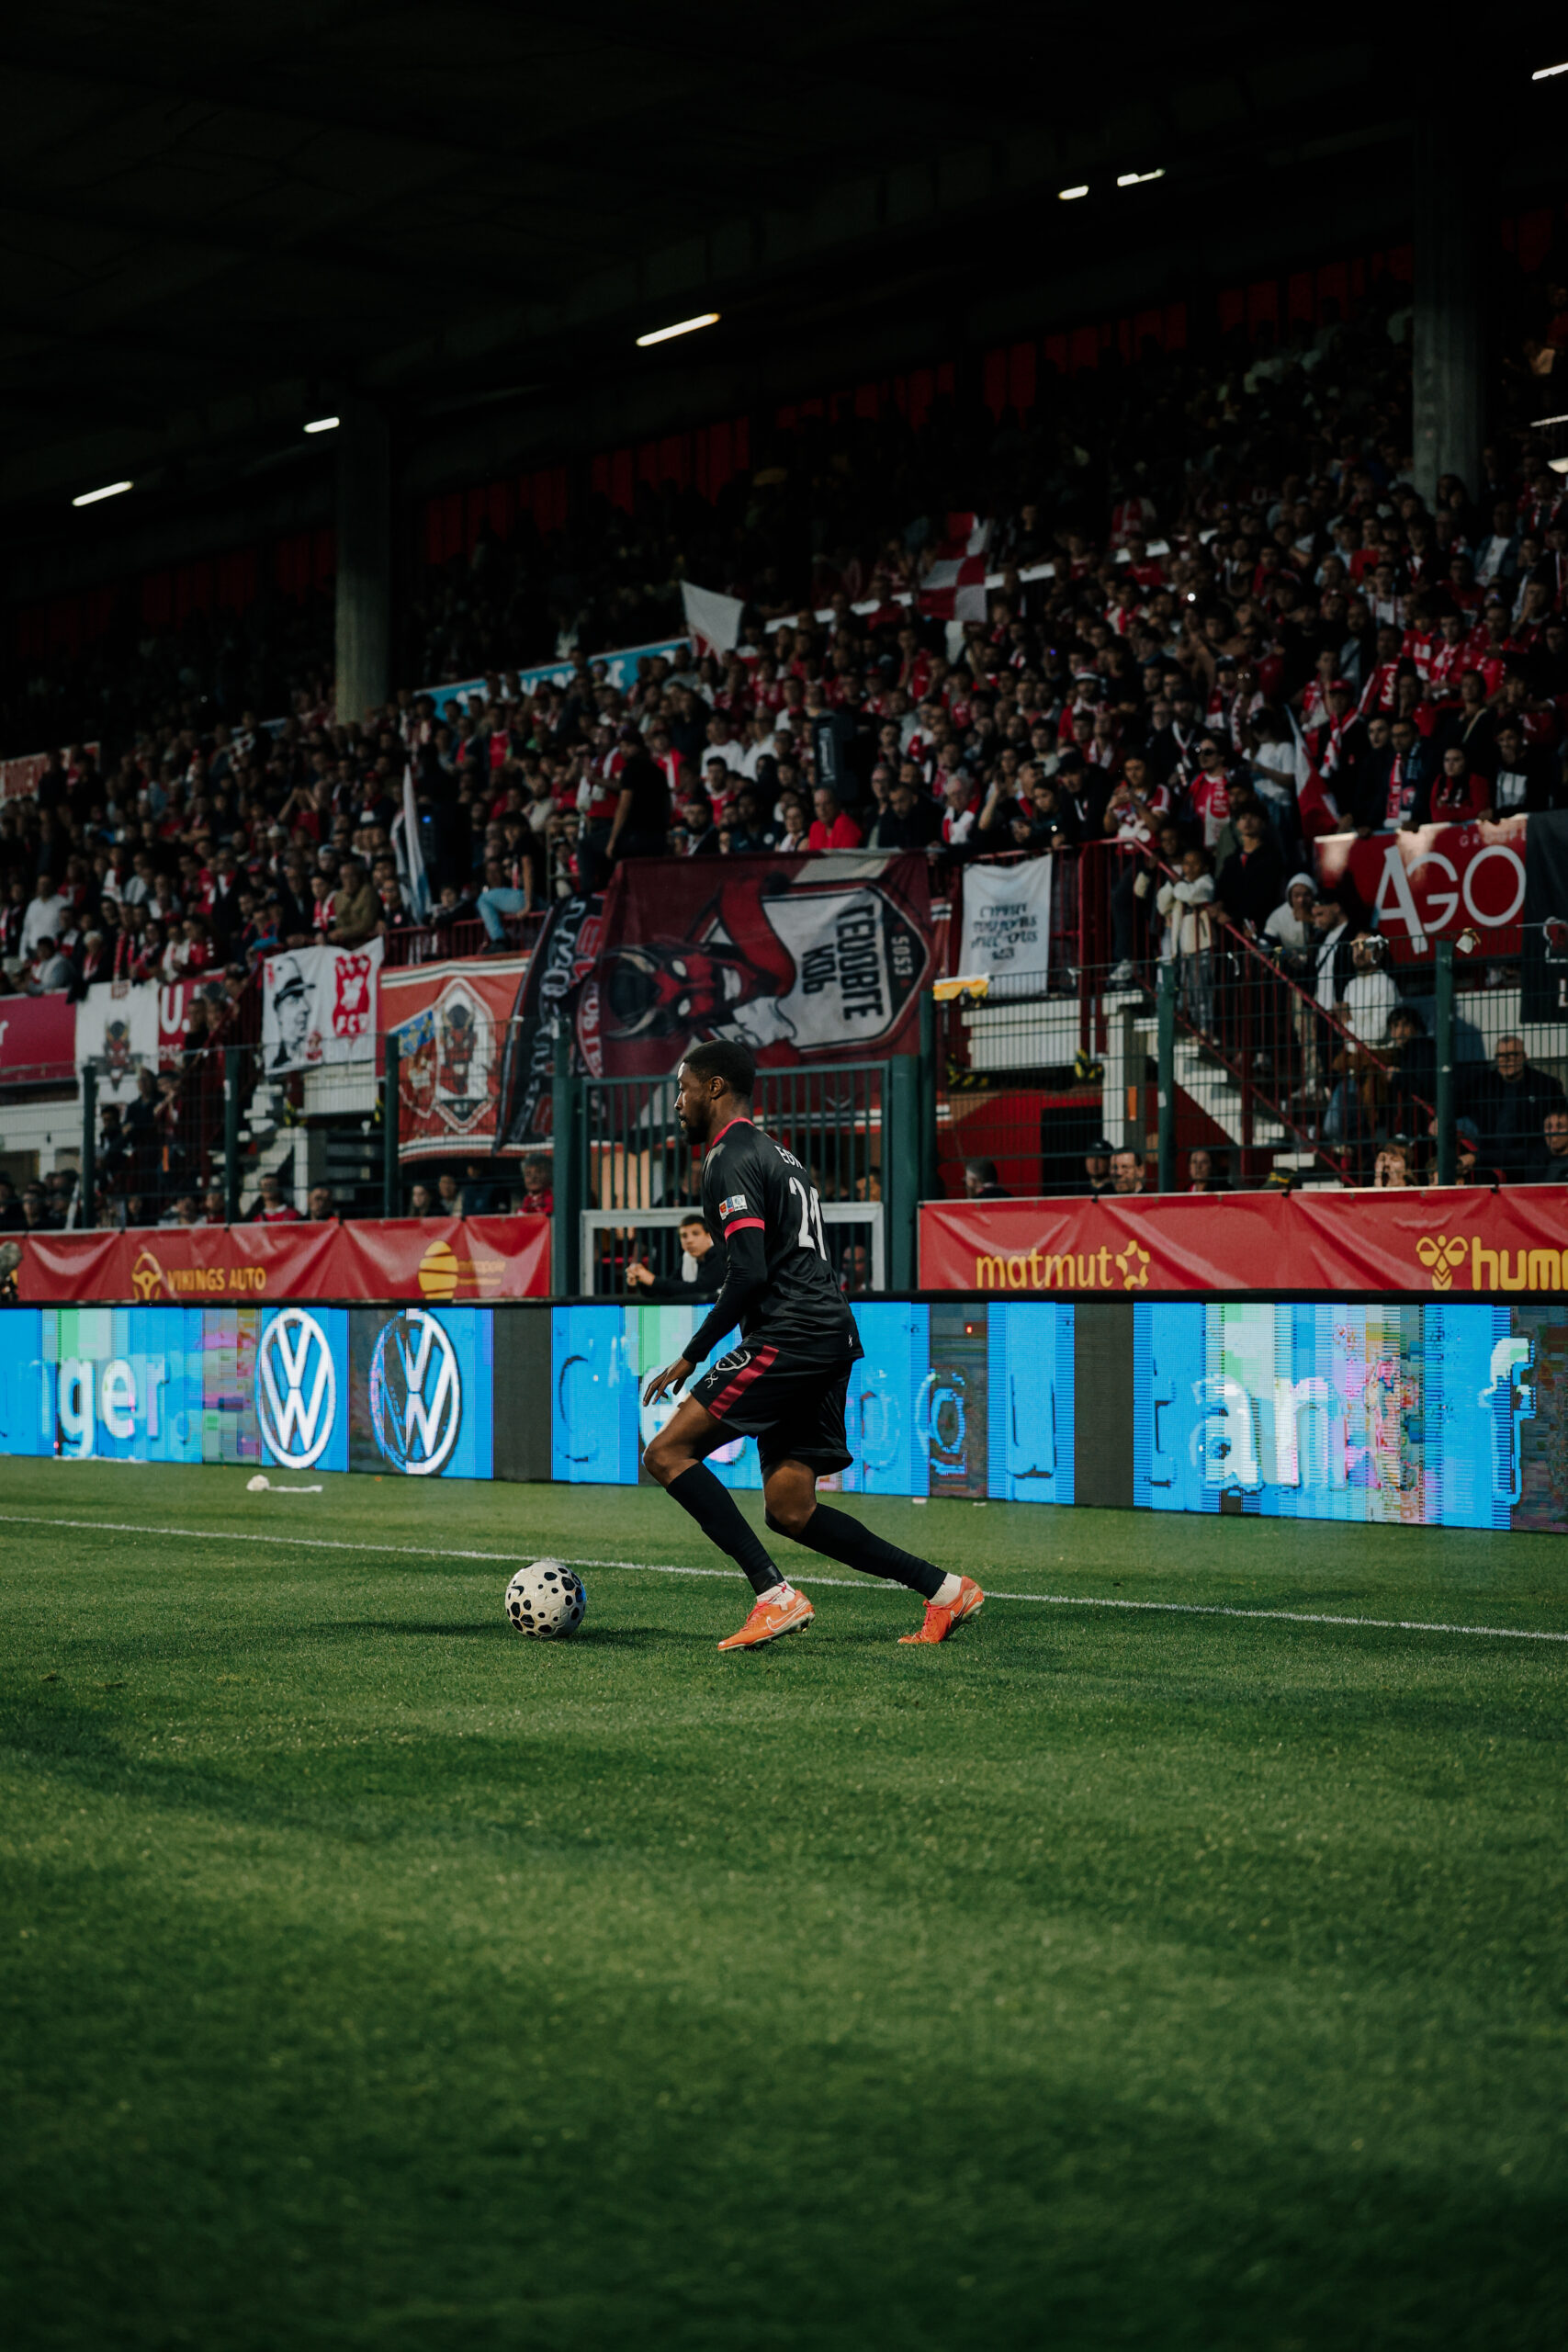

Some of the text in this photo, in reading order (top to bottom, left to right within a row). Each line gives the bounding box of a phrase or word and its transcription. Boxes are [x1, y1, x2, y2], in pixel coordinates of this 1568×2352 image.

[1371, 844, 1527, 956] AGO
[167, 1267, 267, 1291] VIKINGS AUTO
[976, 1246, 1114, 1289] matmut
[1472, 1236, 1568, 1291] hum
